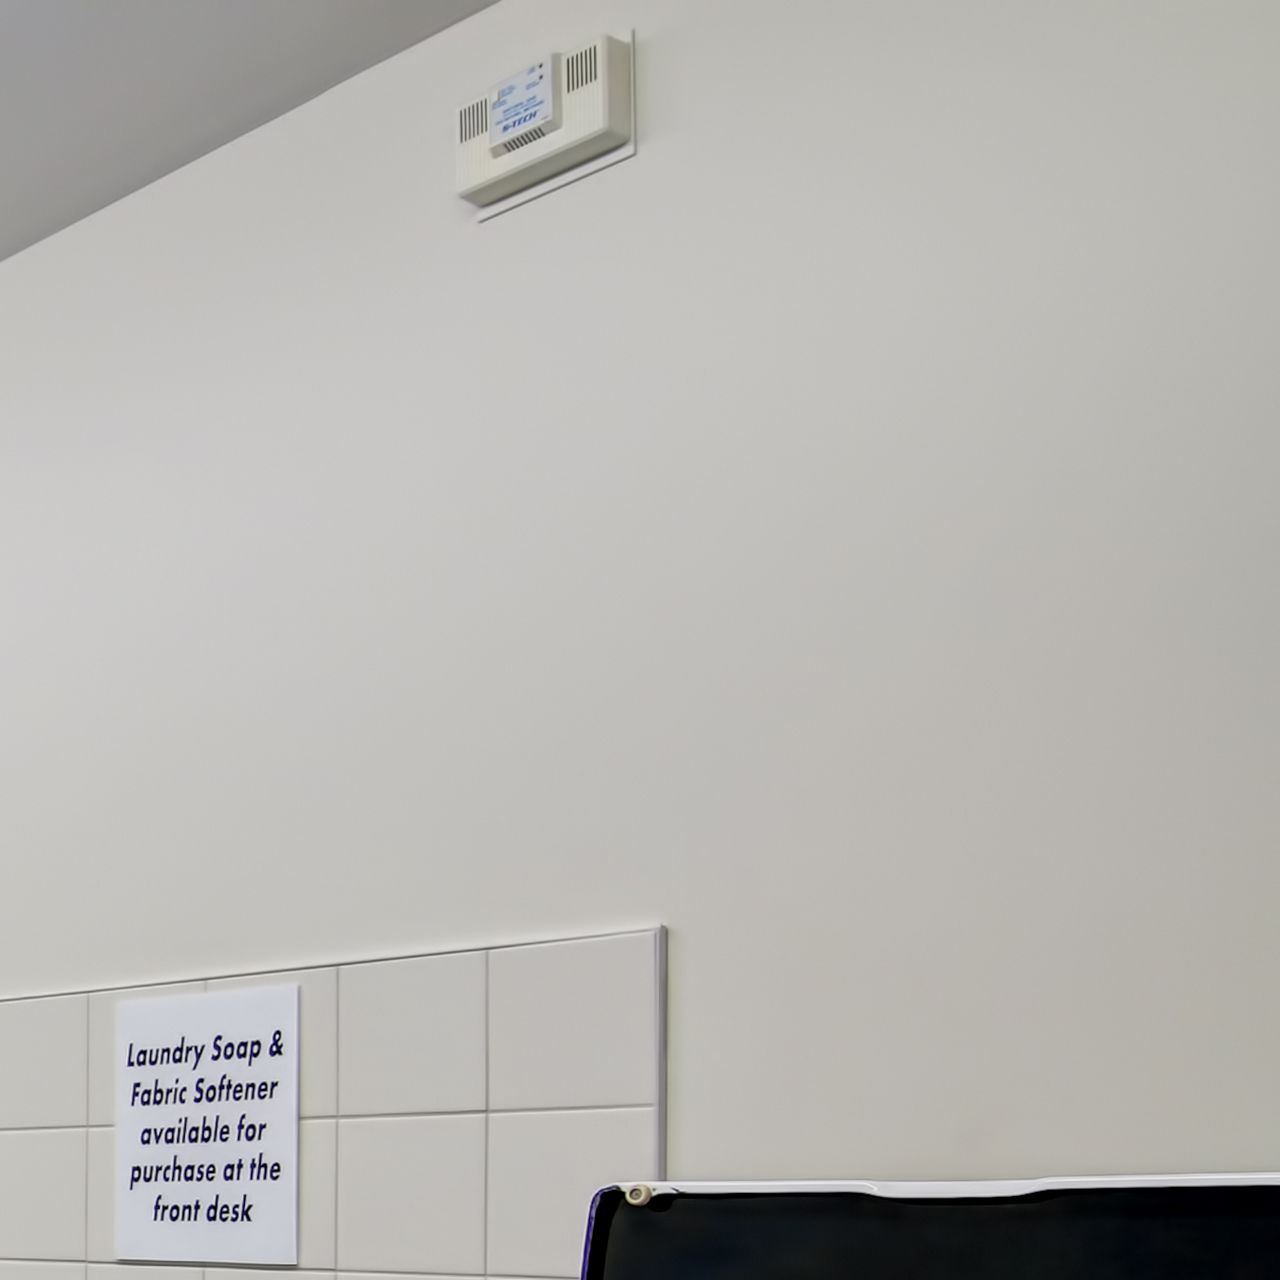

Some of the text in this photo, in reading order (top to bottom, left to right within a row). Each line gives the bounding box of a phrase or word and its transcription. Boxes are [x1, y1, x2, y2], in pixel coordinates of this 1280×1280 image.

[127, 1029, 284, 1070] Laundry Soap &
[131, 1074, 279, 1106] Fabric Softener
[140, 1113, 266, 1144] available for
[130, 1152, 281, 1190] purchase at the
[153, 1194, 253, 1222] front desk
